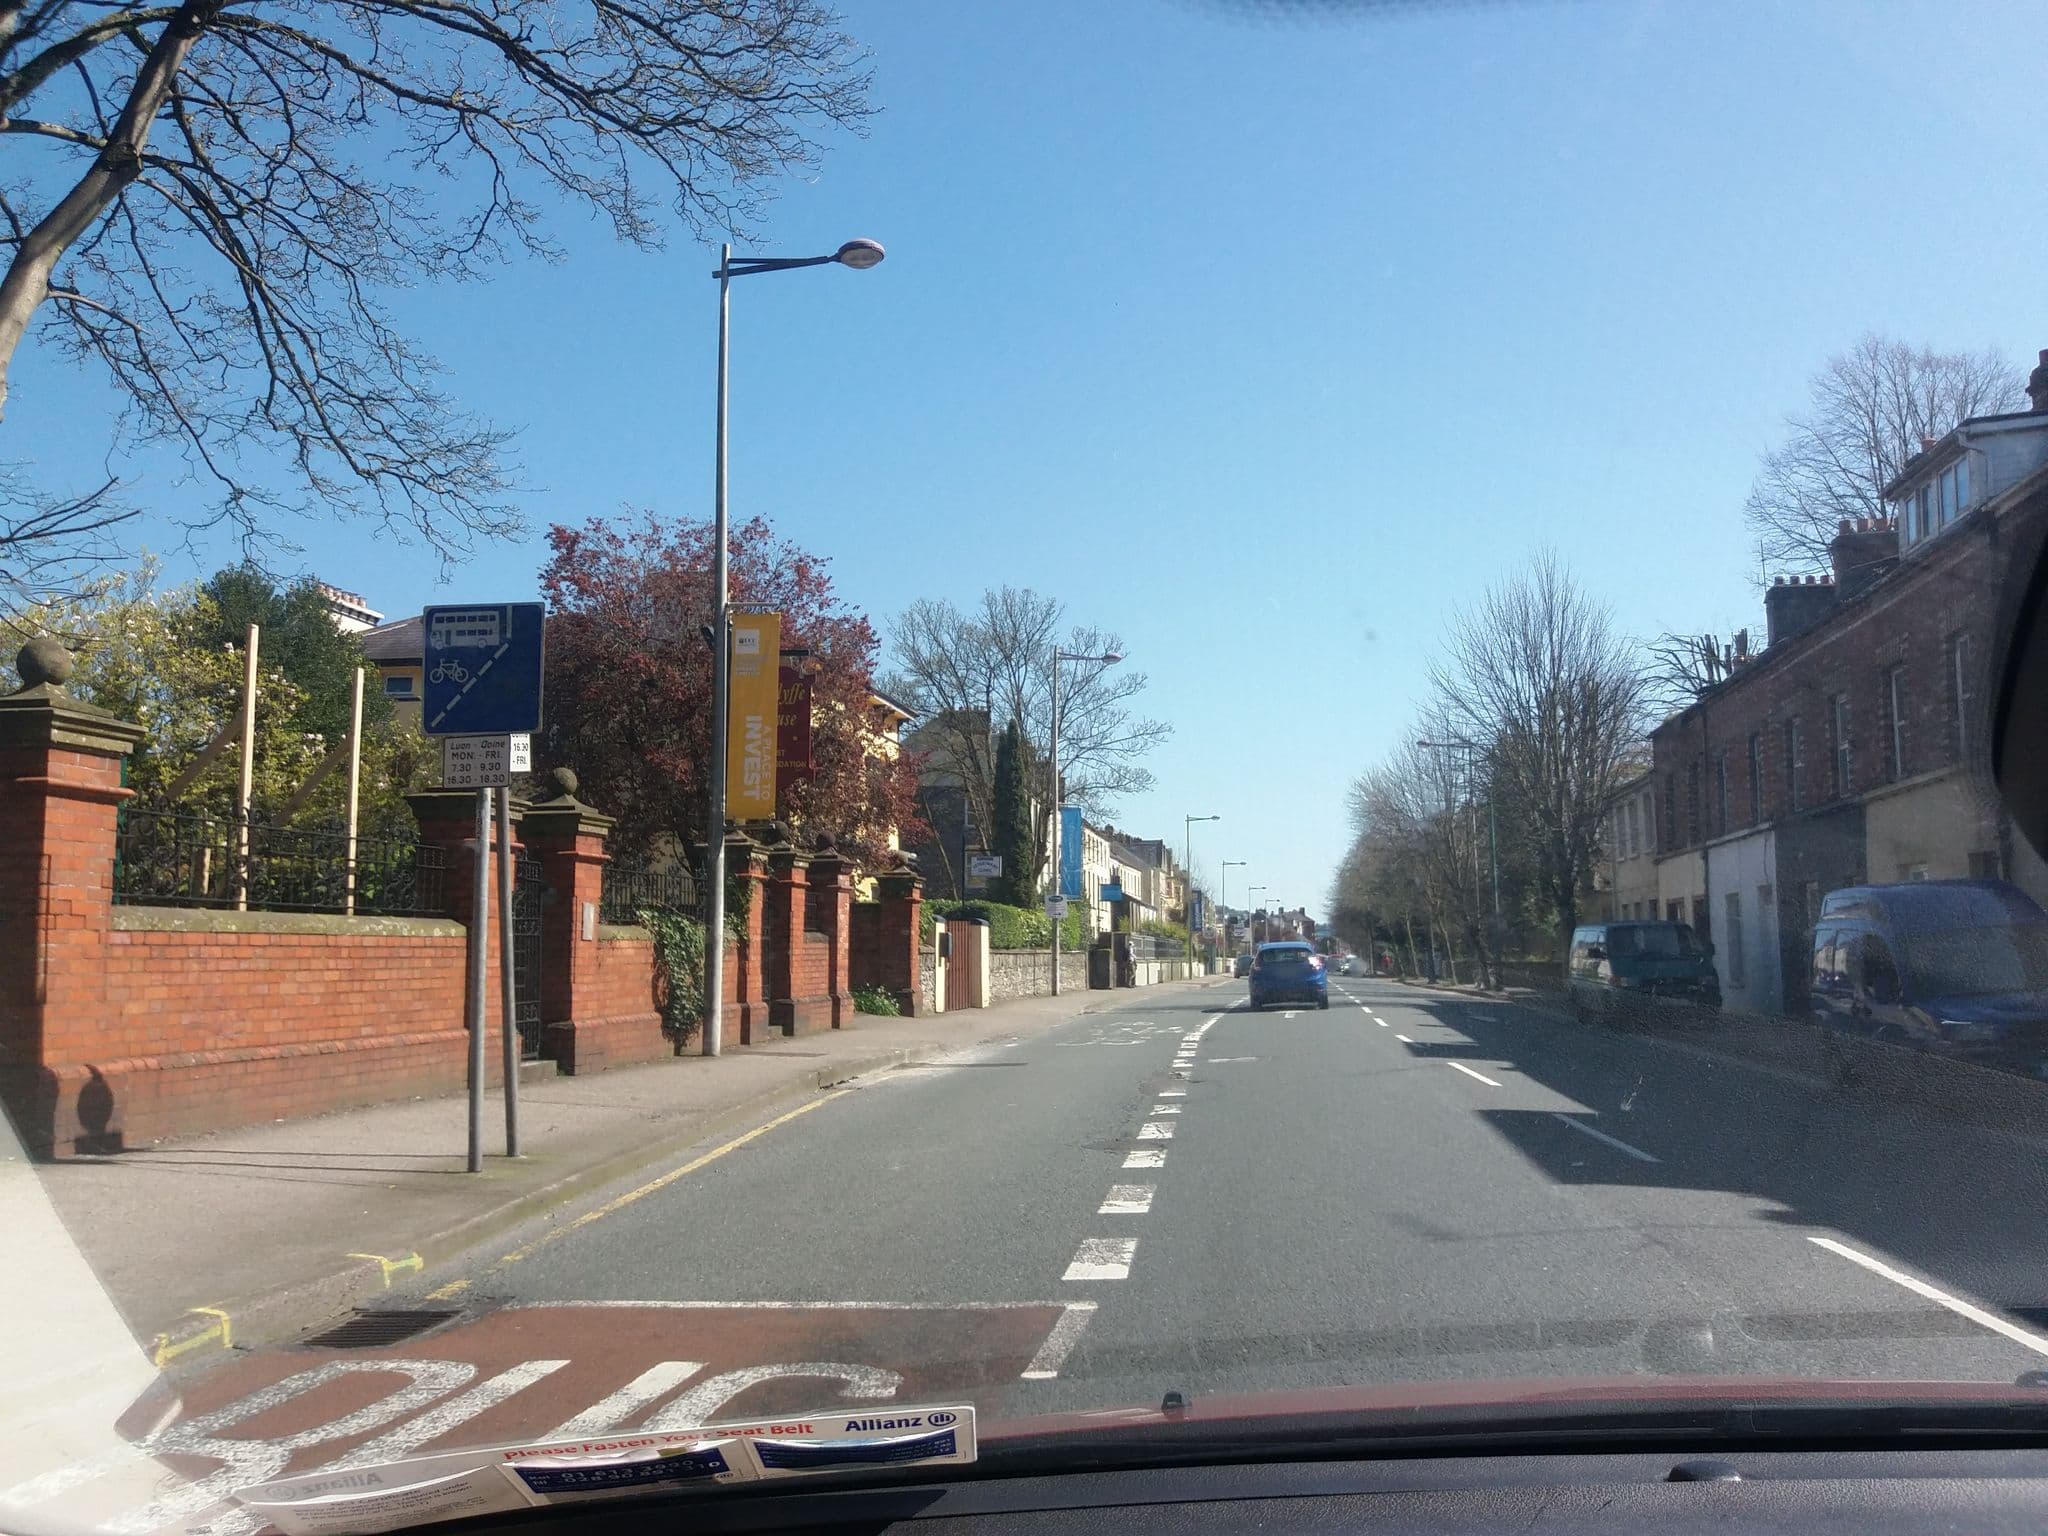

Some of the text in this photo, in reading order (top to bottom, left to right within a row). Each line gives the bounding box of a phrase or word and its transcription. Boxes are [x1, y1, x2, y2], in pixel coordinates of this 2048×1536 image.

[480, 762, 501, 771] 9.30
[744, 715, 763, 800] INVEST
[762, 738, 772, 779] PLACE
[761, 784, 771, 801] TO
[845, 1416, 923, 1432] Allianz
[503, 1423, 813, 1460] Please Fasten Your Seat Belt
